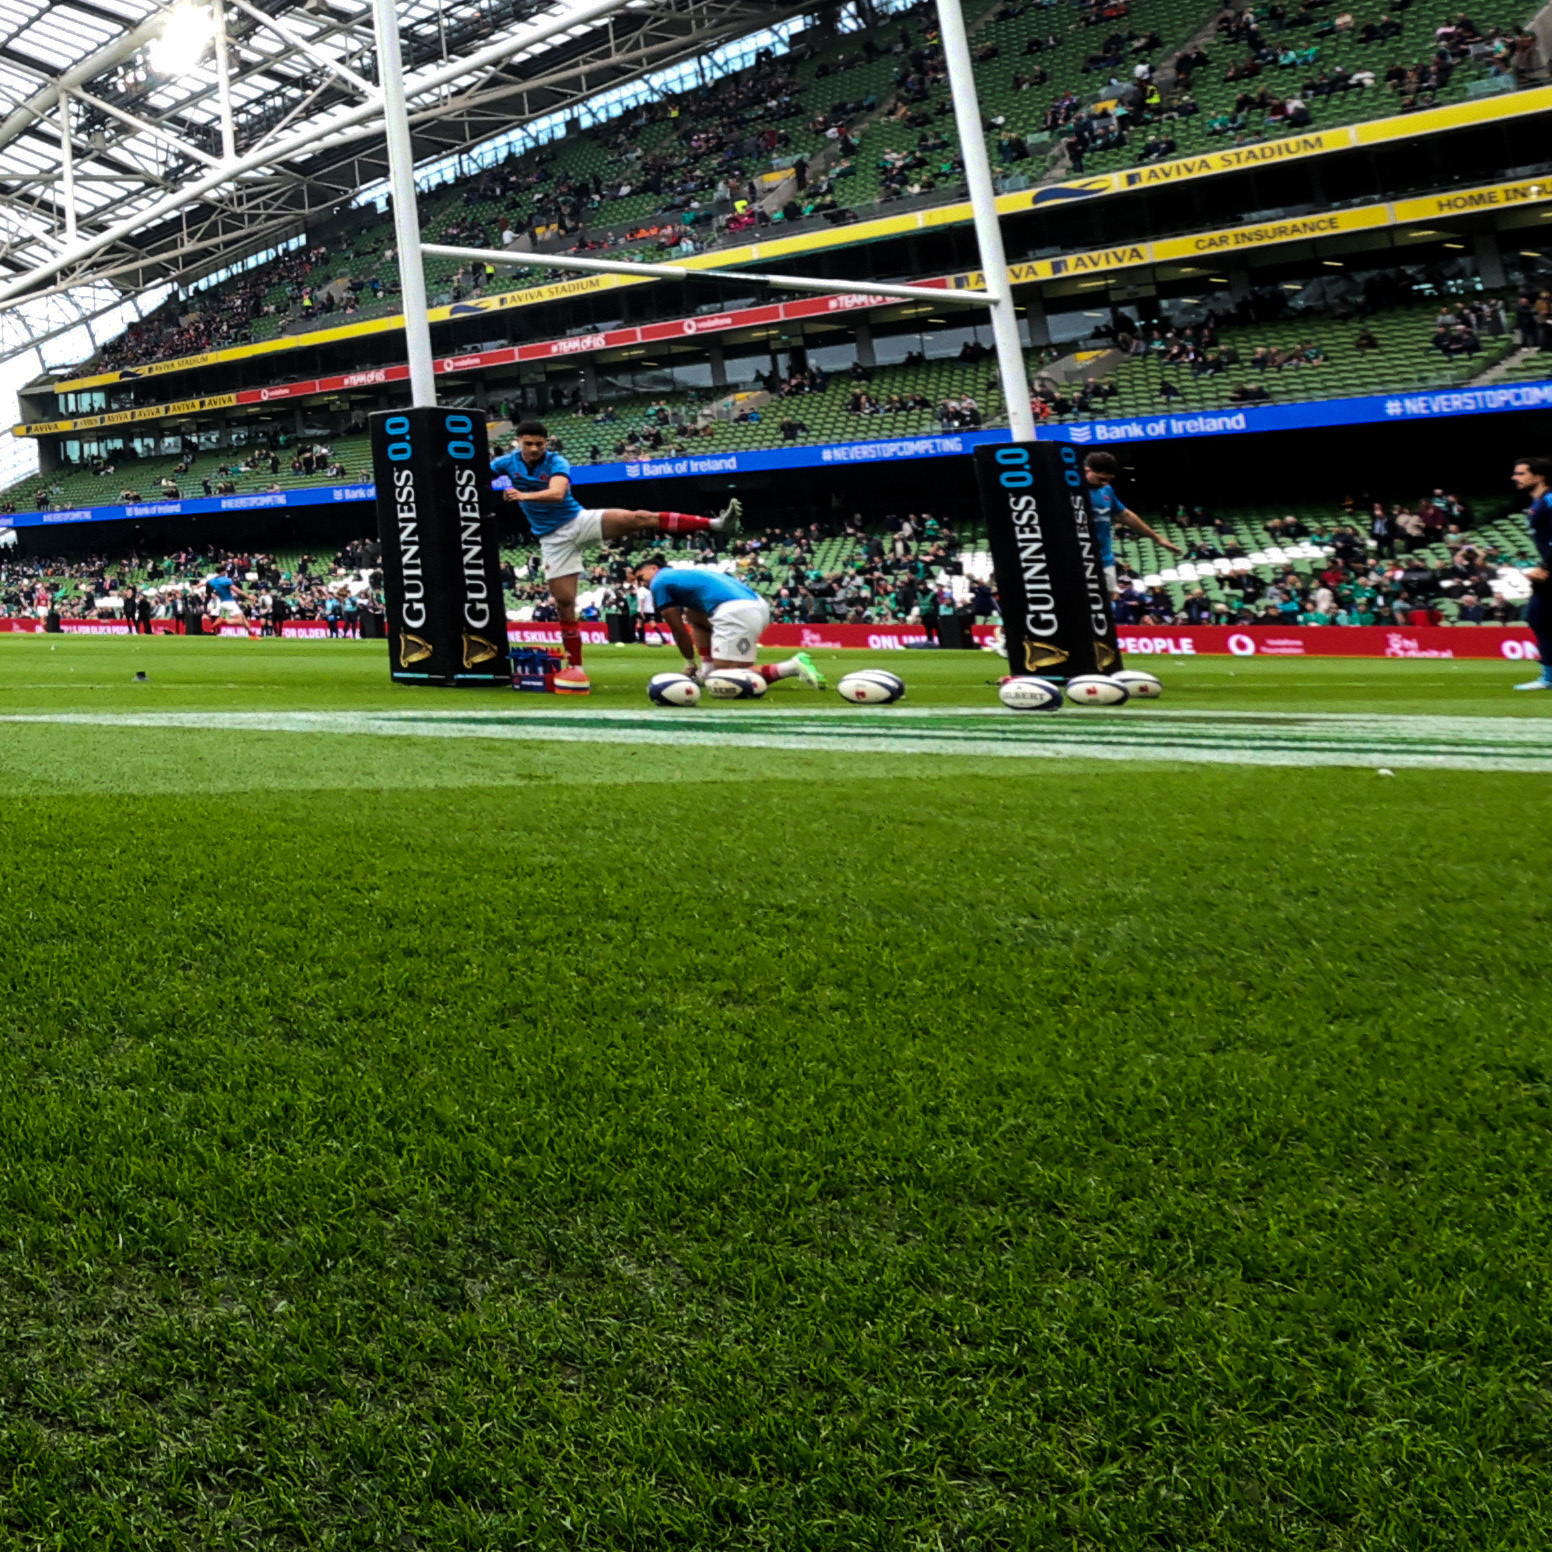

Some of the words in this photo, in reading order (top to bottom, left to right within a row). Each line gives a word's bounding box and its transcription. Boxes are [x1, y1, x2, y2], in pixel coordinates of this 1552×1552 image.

[1147, 158, 1212, 182] AVIVA
[1219, 136, 1324, 168] STADIUM
[1437, 191, 1500, 212] HOME
[1194, 234, 1230, 251] CAR
[1232, 216, 1340, 245] INSURANCE
[1074, 247, 1145, 271] AVIVA
[975, 264, 1038, 287] AVA
[508, 290, 544, 306] AVIVA
[547, 278, 601, 298] STADIUM
[551, 341, 580, 354] #TEAM
[171, 401, 197, 414] AVIVA
[207, 395, 234, 408] AVIVA
[385, 416, 413, 462] 0.0
[446, 414, 475, 460] 0.0
[1095, 422, 1145, 441] Bank
[1146, 419, 1168, 437] of
[1171, 413, 1247, 435] Ireland
[821, 437, 963, 461] #NEVERSTOPCOMPETING
[642, 460, 674, 477] Bank
[676, 458, 688, 474] of
[689, 455, 738, 472] Ireland
[995, 447, 1034, 489] 0.0
[1059, 446, 1082, 488] 0.0
[393, 468, 427, 629] GUINNESS
[455, 468, 491, 629] GUINNESS
[1008, 494, 1059, 637] GUINNESS
[1070, 495, 1108, 637] GUINNESS
[1117, 637, 1195, 654] PEOPLE
